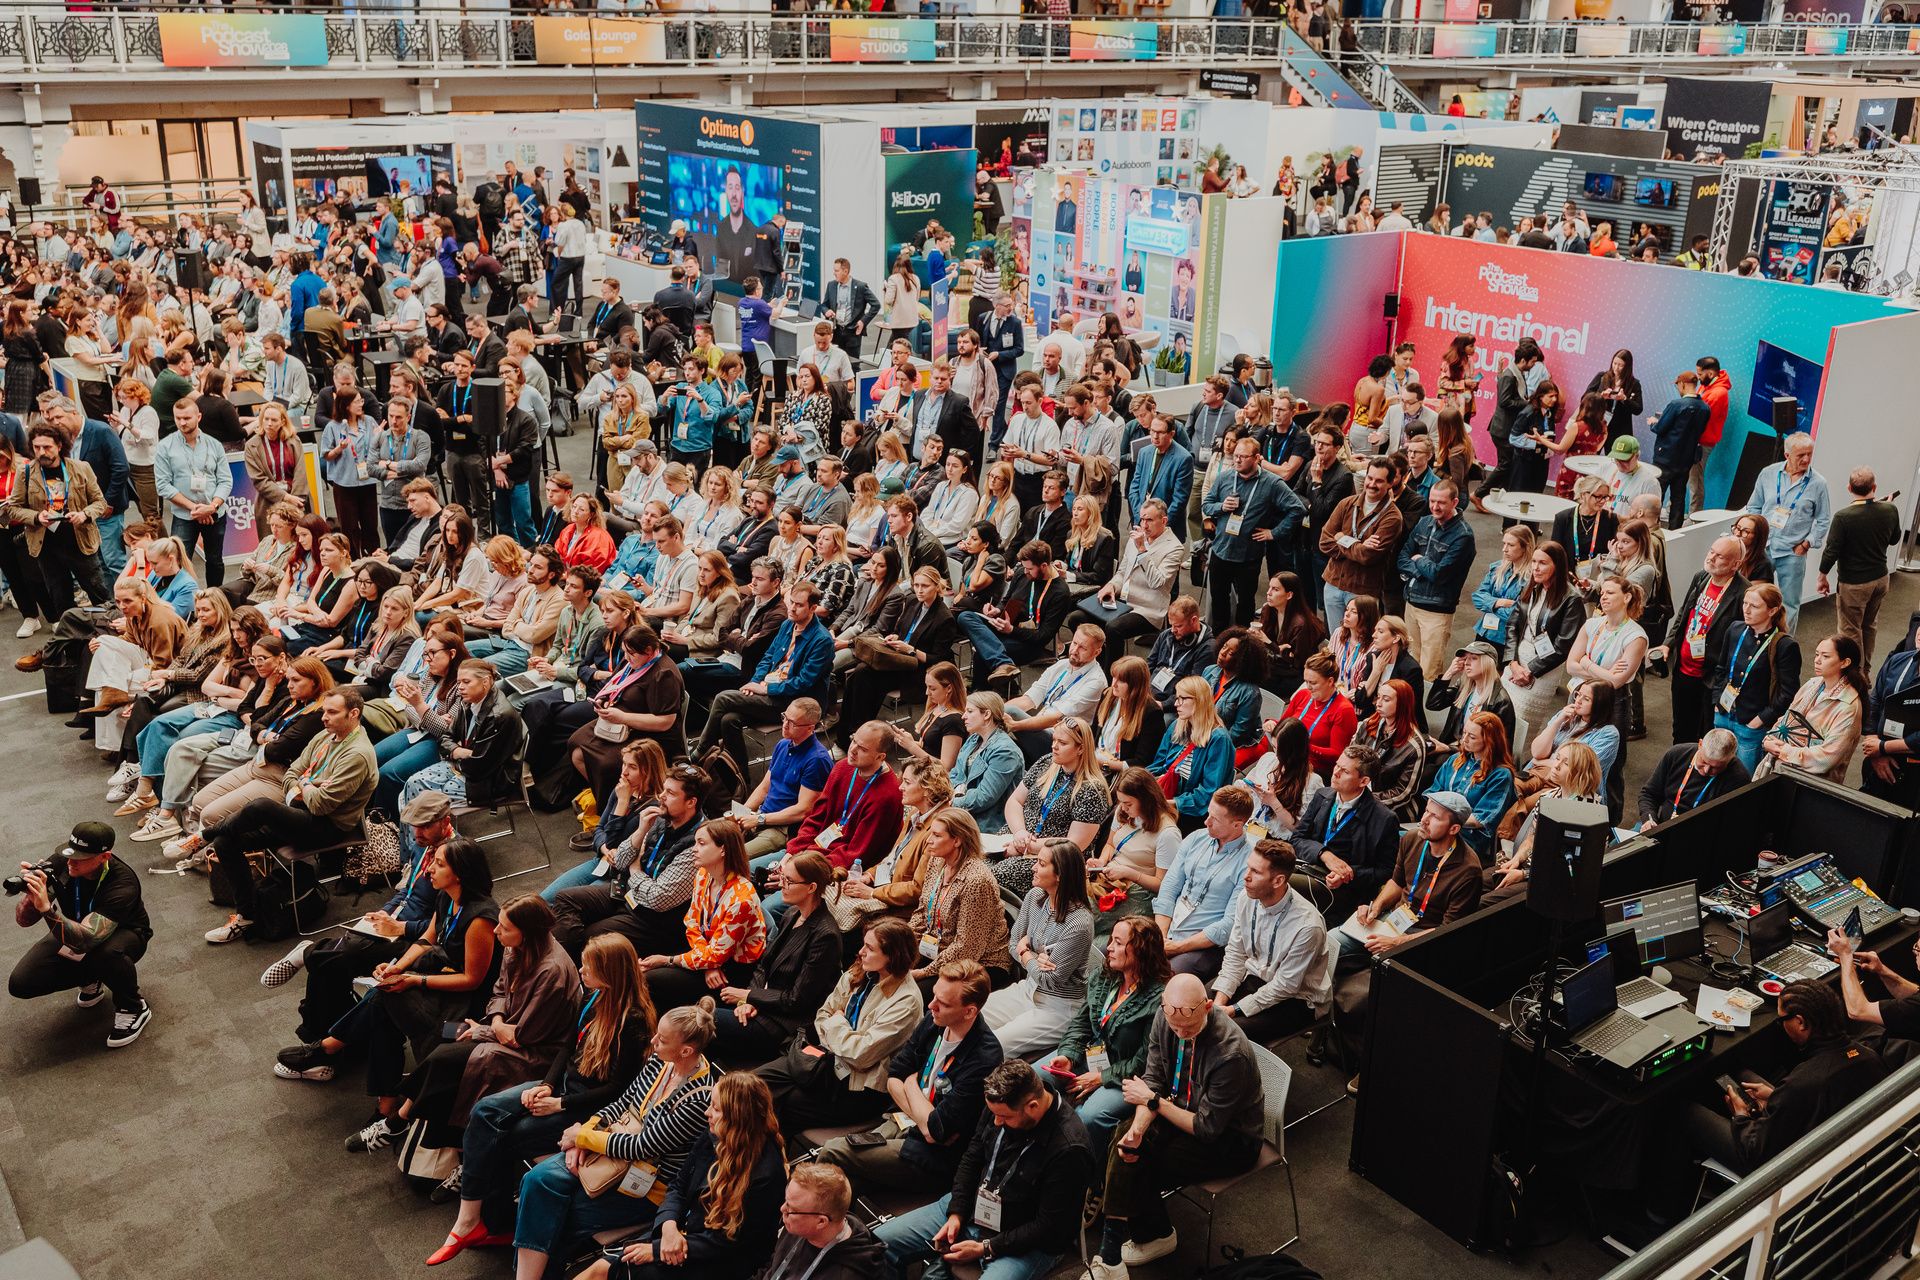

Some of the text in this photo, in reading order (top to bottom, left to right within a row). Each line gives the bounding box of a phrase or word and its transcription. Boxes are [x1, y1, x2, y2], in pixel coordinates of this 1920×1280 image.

[1782, 8, 1851, 26] ecision
[201, 27, 271, 43] Podcast
[563, 29, 637, 43] Gold Lounge
[1093, 32, 1136, 49] Acast
[218, 40, 266, 56] Show
[860, 43, 909, 53] STUDIOS
[700, 116, 740, 139] Optima
[1667, 116, 1706, 130] Where
[1706, 119, 1760, 134] Creators
[1681, 129, 1741, 144] Get Heard
[262, 156, 280, 164] Your
[316, 154, 325, 162] AI
[325, 152, 364, 162] Podcasting
[1111, 160, 1151, 170] Audioboom
[1454, 152, 1496, 169] podx
[903, 191, 941, 209] libsyn
[1084, 189, 1093, 248] PODCASTS
[1092, 191, 1100, 231] PEOPLE
[1773, 206, 1823, 225] 11 LEAGUE
[1203, 205, 1220, 355] ENTERTAINMENT SPECIALISTS
[1478, 266, 1529, 287] Podcast
[1487, 281, 1521, 297] Show
[1424, 296, 1590, 355] International
[1483, 388, 1495, 400] BY
[227, 495, 247, 507] The
